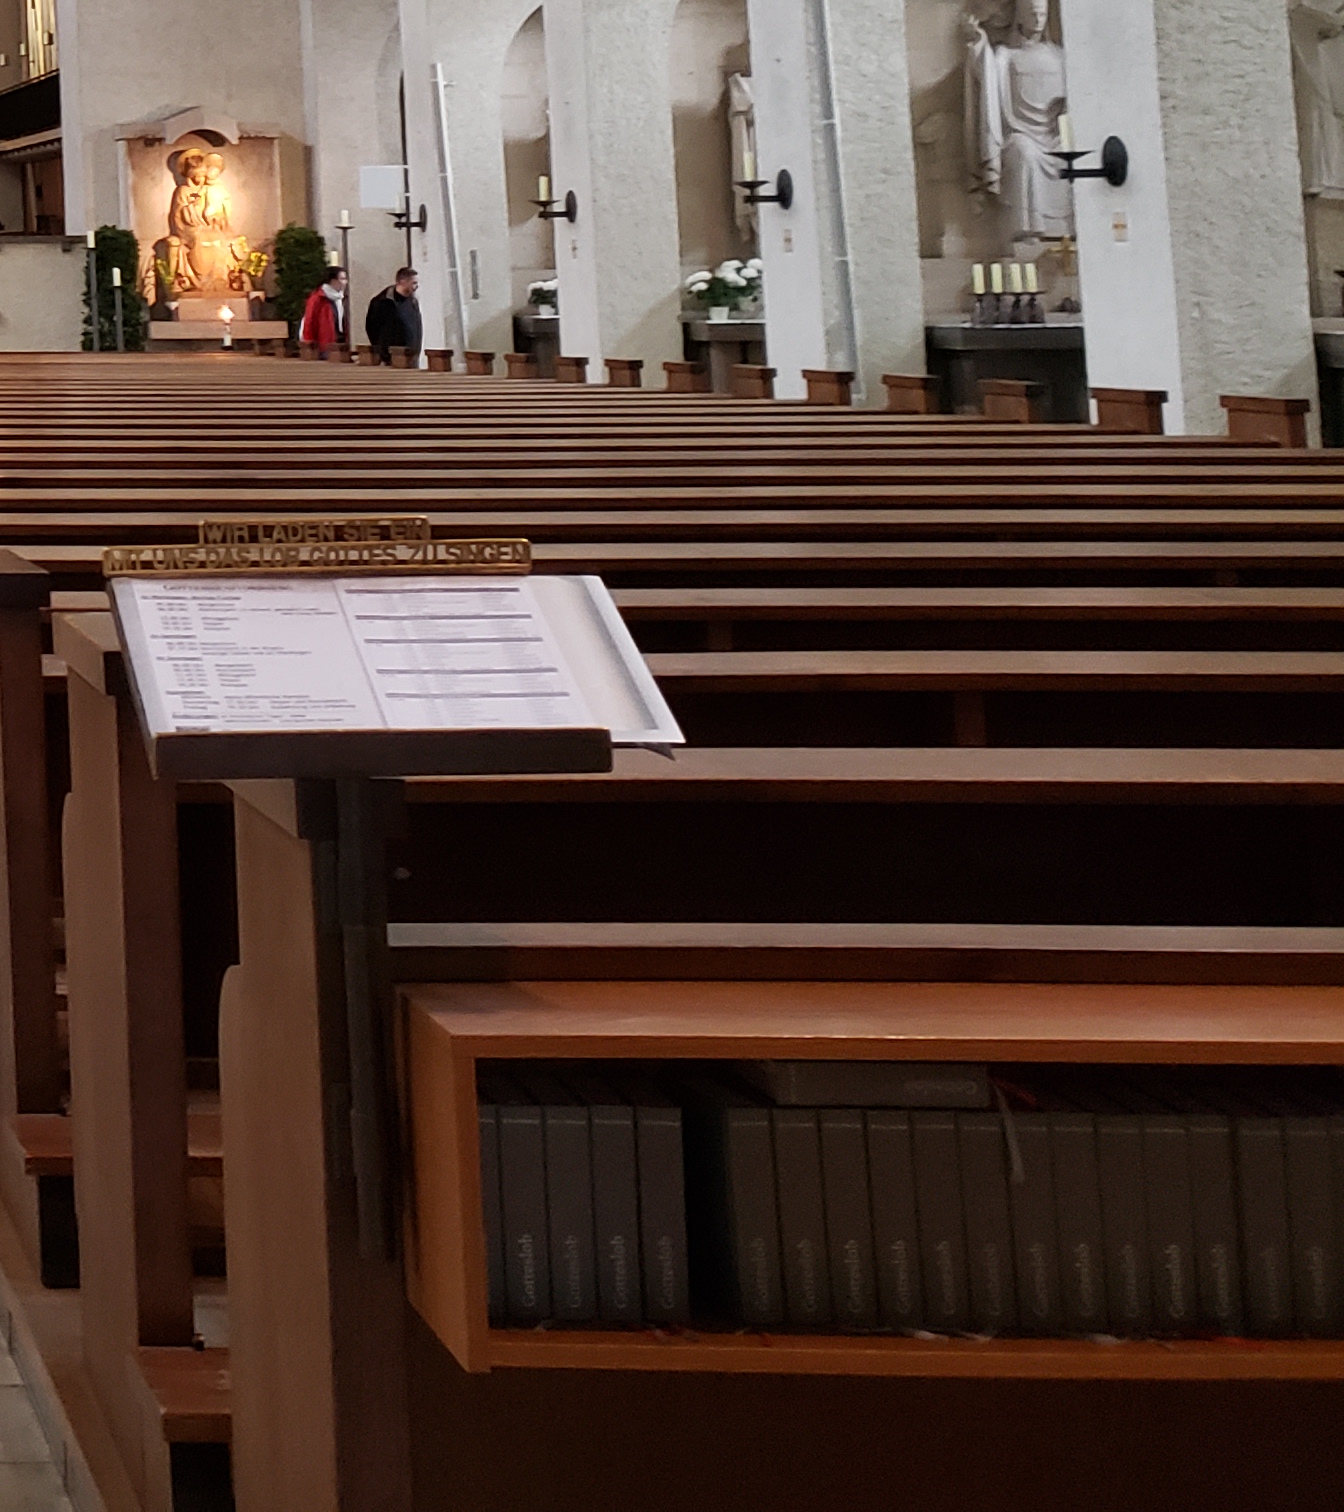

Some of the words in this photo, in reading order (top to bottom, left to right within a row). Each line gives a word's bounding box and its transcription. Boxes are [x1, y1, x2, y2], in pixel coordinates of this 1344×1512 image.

[207, 524, 249, 544] WIR
[258, 522, 334, 544] LADEN
[343, 521, 381, 542] SIE
[390, 519, 428, 541] EIN
[109, 549, 142, 571] MIT
[152, 548, 200, 570] UNS
[206, 548, 252, 569] DAS
[259, 547, 300, 568] LOB
[310, 545, 397, 567] GOTTES
[411, 544, 438, 565] ZU
[445, 543, 530, 564] SINGEN
